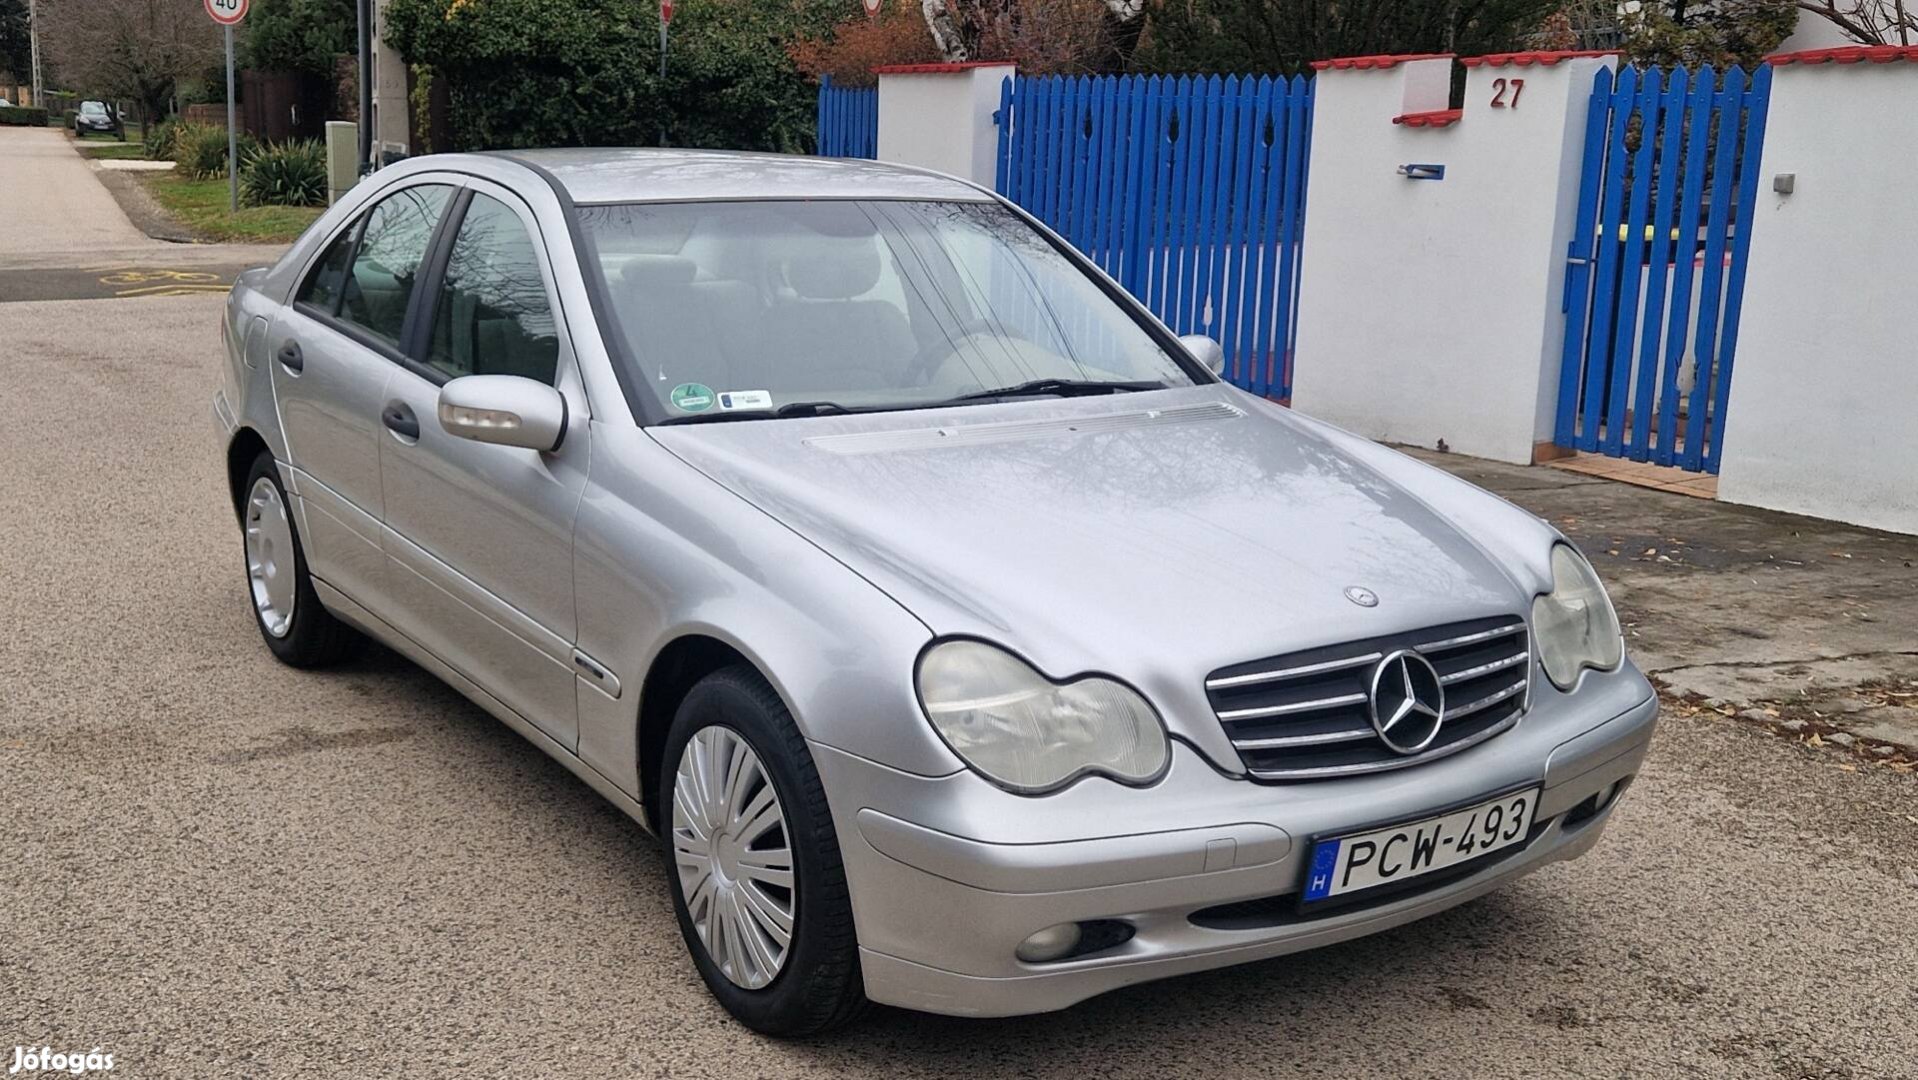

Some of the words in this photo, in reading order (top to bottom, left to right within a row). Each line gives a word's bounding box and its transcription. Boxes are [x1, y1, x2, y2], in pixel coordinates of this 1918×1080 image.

[216, 0, 237, 10] 40
[1490, 78, 1524, 108] 27
[1342, 797, 1527, 887] PCW-493
[1312, 876, 1324, 891] H
